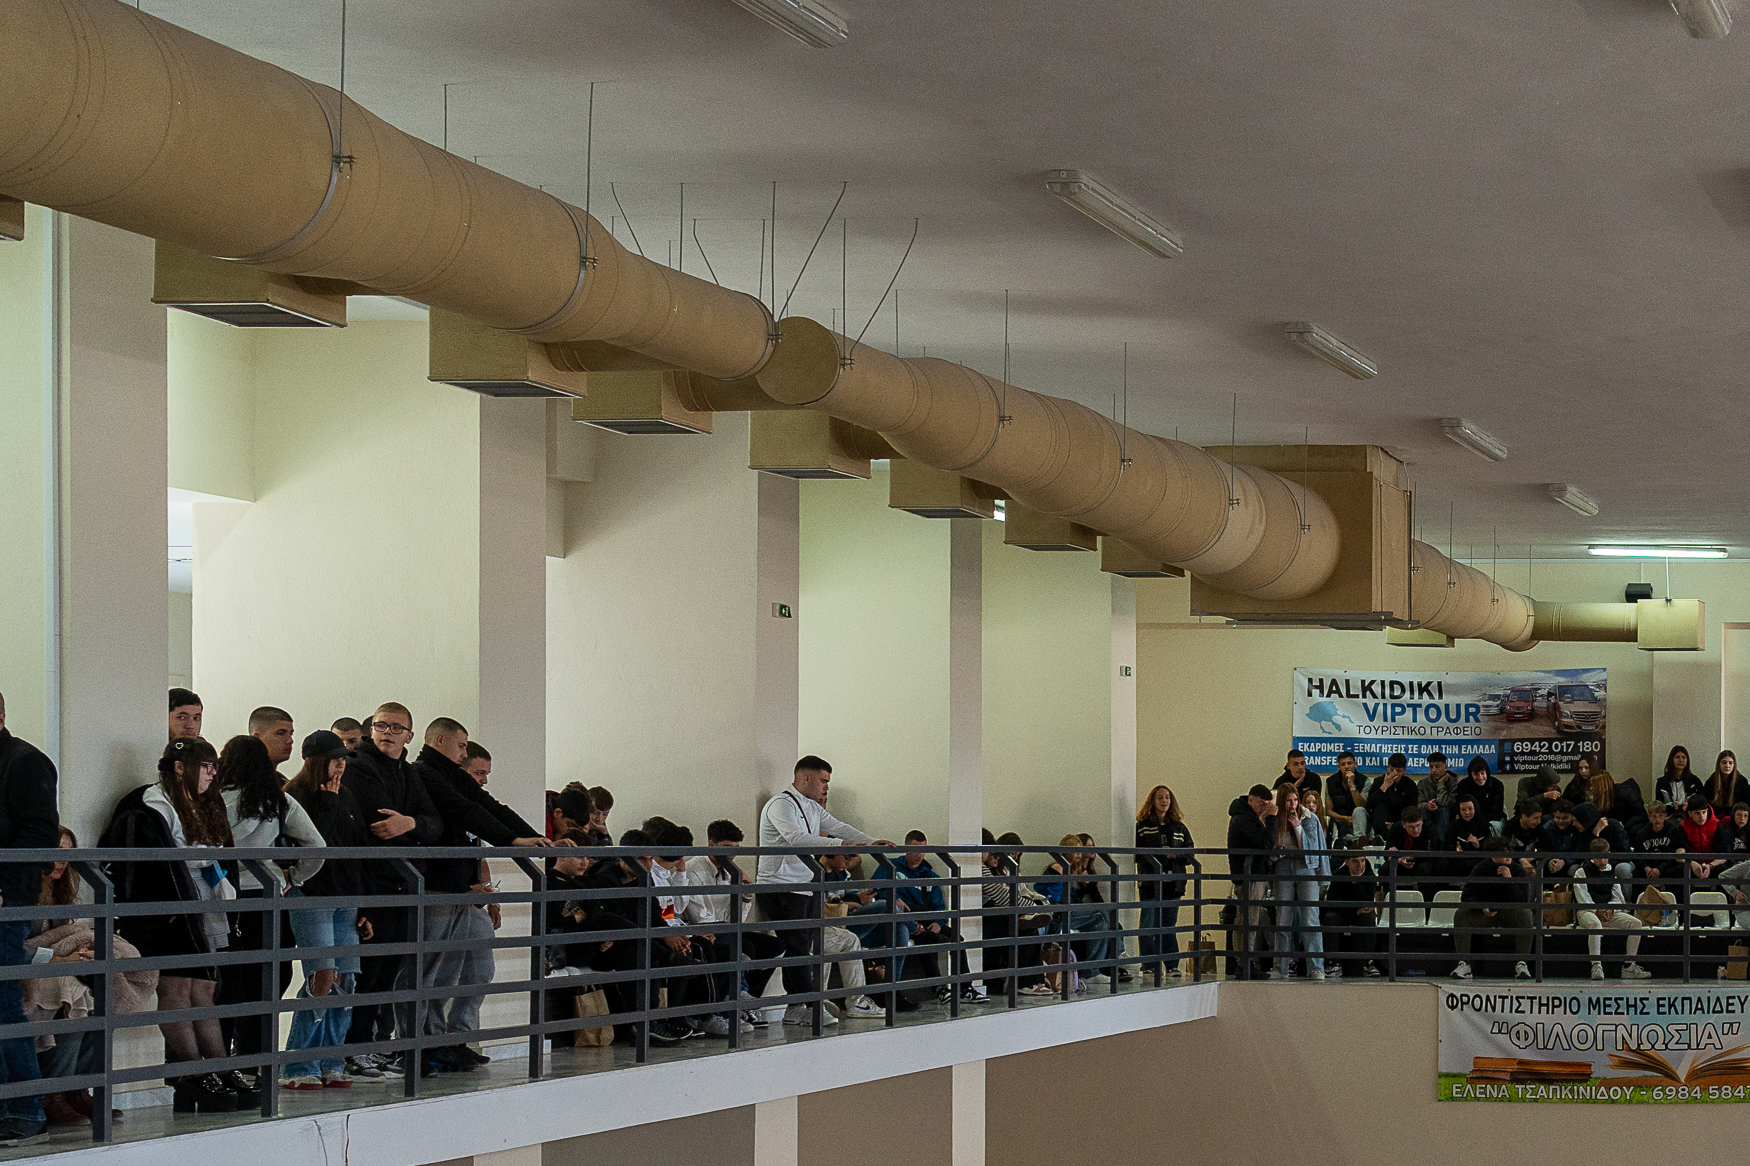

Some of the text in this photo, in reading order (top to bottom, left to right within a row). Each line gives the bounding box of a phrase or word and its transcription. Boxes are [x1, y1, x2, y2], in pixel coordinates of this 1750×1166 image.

[1306, 677, 1444, 700] HALKIDIKI
[1361, 702, 1482, 724] VIPTOUR
[1356, 725, 1482, 736] ΤΟΥΡΙΣΤΙΚΟ ΓΡΑΦΕΙΟ
[1298, 742, 1344, 752] ΕΚΔΡΟΜΕΣ
[1354, 743, 1406, 754] ΞΕΝΑΓΗΣΕΙΣ
[1408, 744, 1418, 754] ΣΕ
[1420, 744, 1440, 754] ΟΛΗ
[1441, 744, 1460, 754] ΤΗΝ
[1462, 744, 1496, 754] ΕΛΛΑΔΑ
[1514, 741, 1600, 753] 6942 017 180
[1304, 756, 1339, 766] RANSFE
[1366, 756, 1380, 766] ΚΑΙ
[1514, 764, 1540, 772] Viptour
[1445, 993, 1580, 1016] ΦΡΟΝΤΙΣΤΗΡΙΟ
[1588, 996, 1650, 1016] ΜΕΣΗΣ
[1452, 1083, 1510, 1098] ΕΛΕΝΑ
[1515, 1084, 1635, 1100] ΤΣΑΠΚΙΝΙΔΟΥ
[1652, 1086, 1702, 1100] 6984
